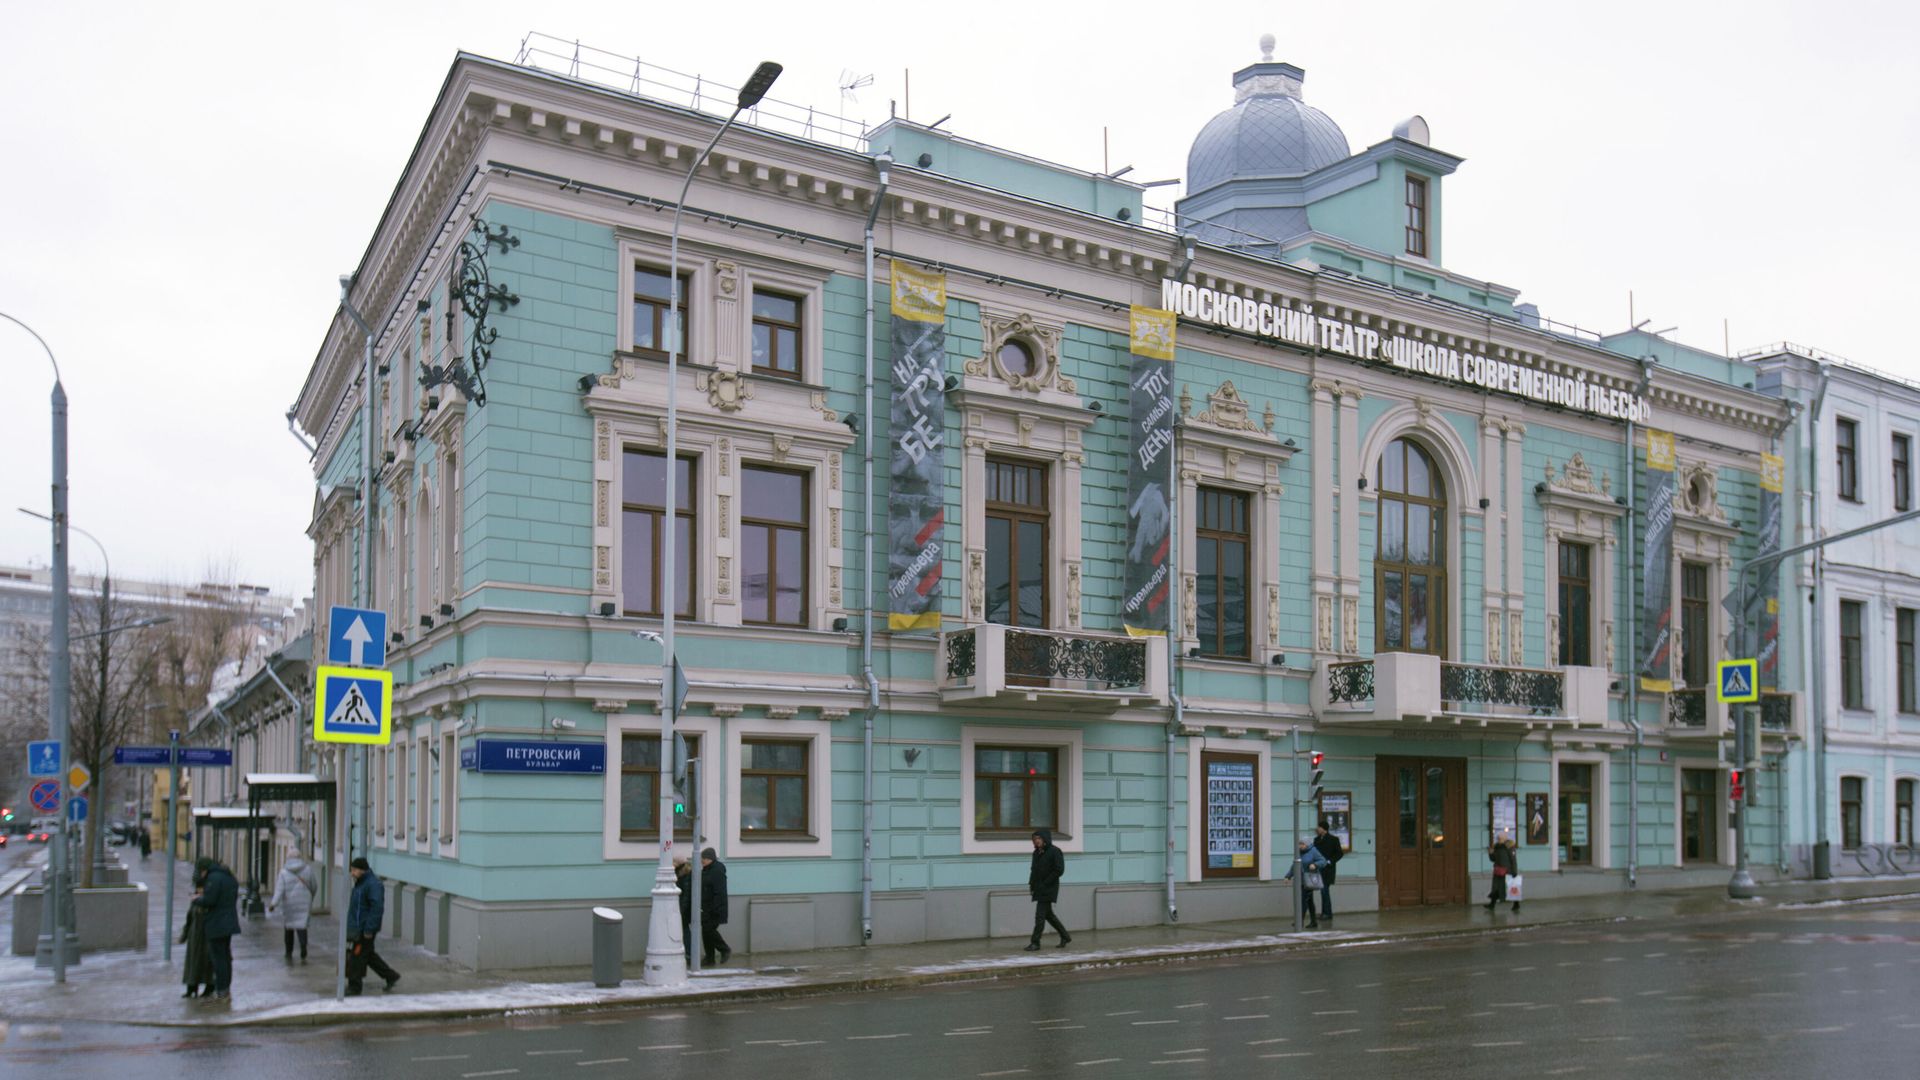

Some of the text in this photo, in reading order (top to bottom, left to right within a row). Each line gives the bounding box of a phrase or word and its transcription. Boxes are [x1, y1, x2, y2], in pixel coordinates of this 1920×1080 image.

[893, 353, 919, 384] НА
[1161, 278, 1652, 422] МОСКОВСКИЙ ТЕАТР «ШКОЛА СОВРЕМЕННОЙ ПЬЕСЫ»
[899, 357, 945, 418] ТРУ
[1141, 366, 1170, 400] ТОТ
[1141, 394, 1173, 433] САМЫЙ
[899, 414, 944, 465] БЕ
[1138, 428, 1173, 471] ДЕНЬ
[890, 541, 940, 599] премьера
[1125, 563, 1167, 613] премьера
[506, 747, 581, 760] ПЕТРОВСКИЙ
